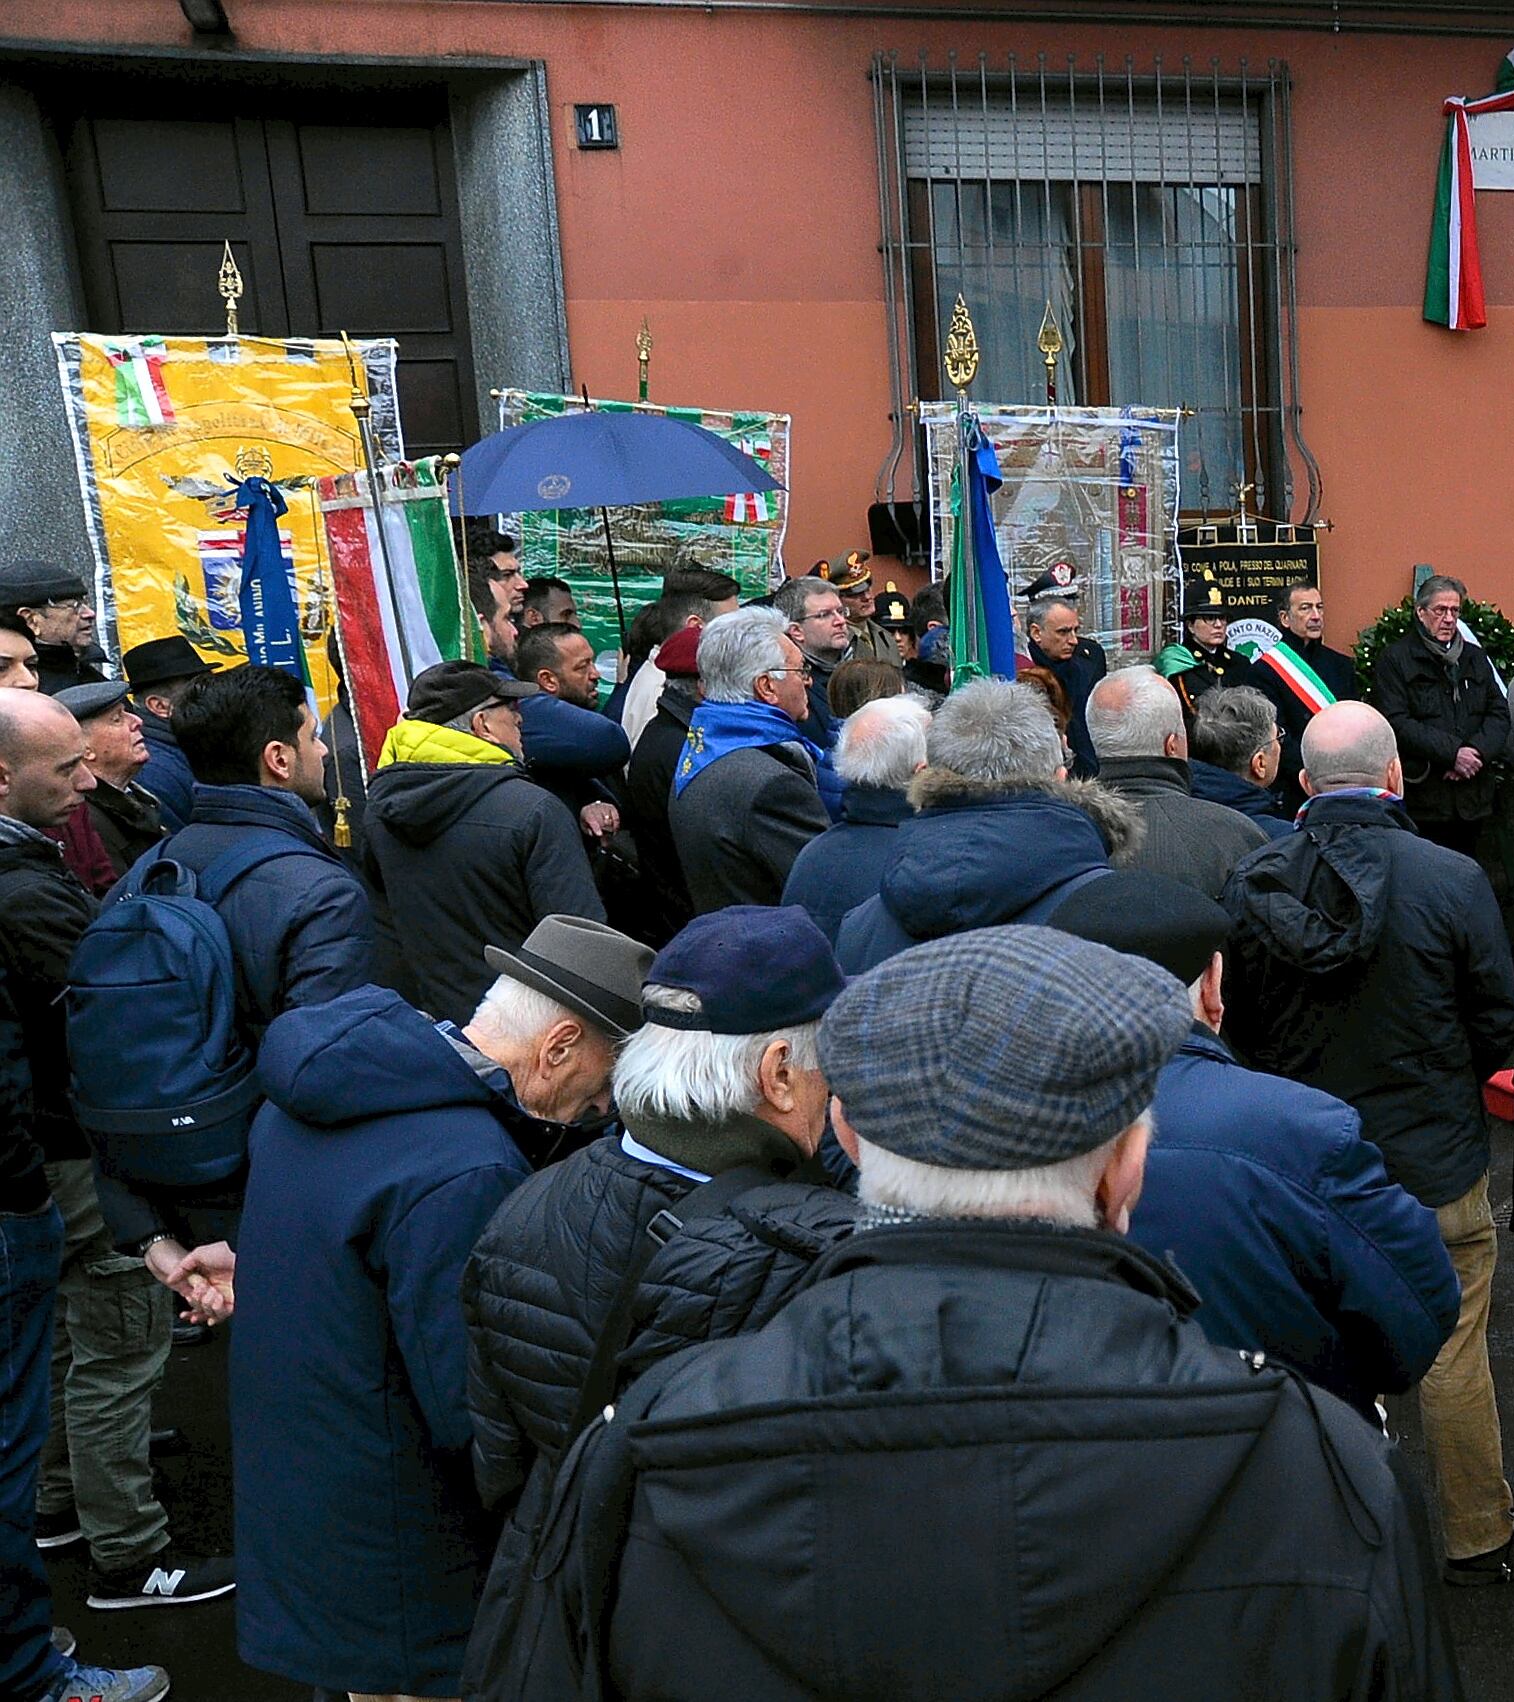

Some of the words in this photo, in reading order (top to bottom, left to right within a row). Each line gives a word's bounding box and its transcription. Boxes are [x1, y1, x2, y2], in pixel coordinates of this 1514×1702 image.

[588, 109, 602, 140] 1
[1212, 562, 1217, 572] A
[1219, 560, 1238, 573] POLA,
[1240, 560, 1263, 571] PRESSO
[1263, 560, 1274, 571] DEL
[1236, 577, 1241, 587] E
[1228, 623, 1253, 638] ENTO
[142, 1567, 186, 1596] N
